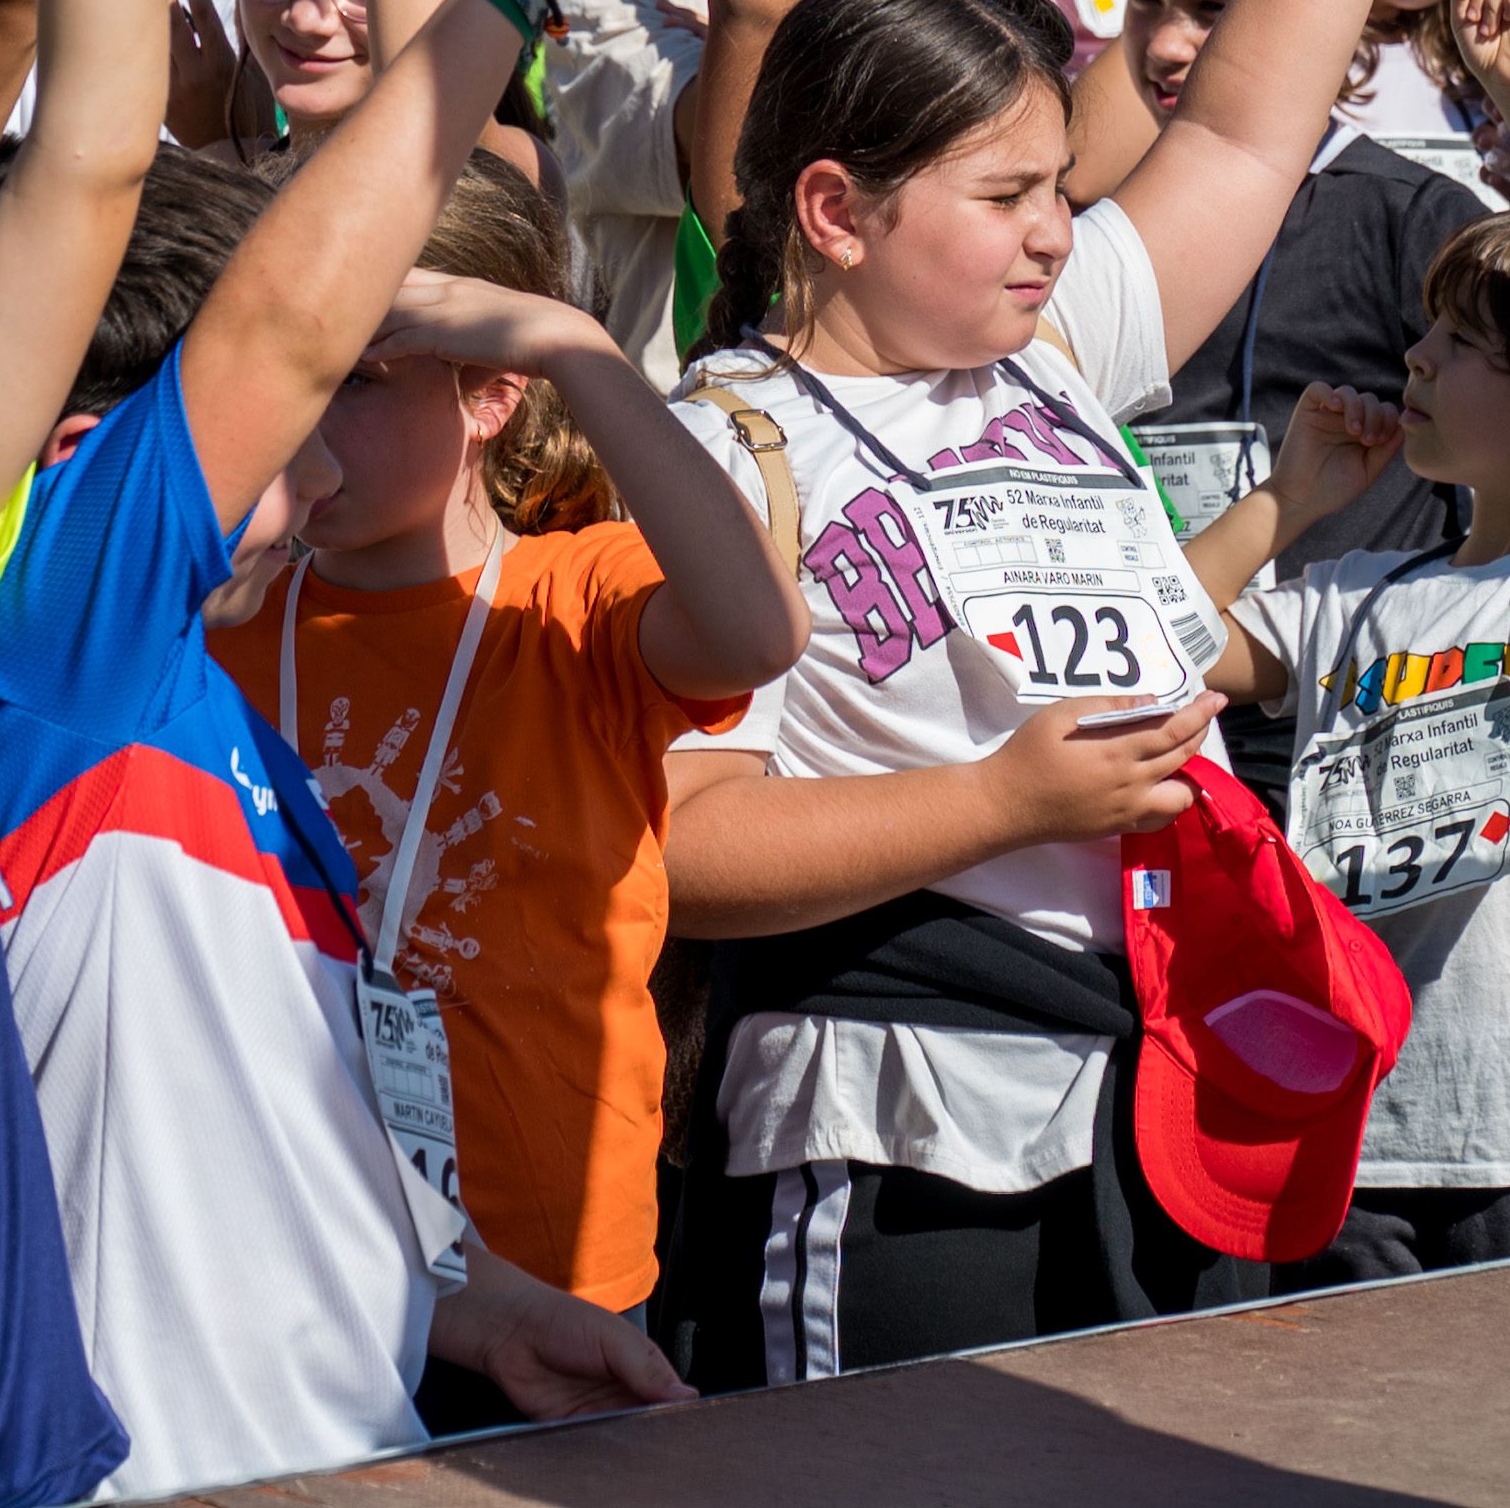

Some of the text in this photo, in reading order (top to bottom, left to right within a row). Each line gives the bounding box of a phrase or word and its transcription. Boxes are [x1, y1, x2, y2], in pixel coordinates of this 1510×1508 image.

[1150, 451, 1196, 466] Infantil
[1006, 489, 1105, 510] 52 Marxa Infantil
[1022, 514, 1038, 529] de
[1040, 515, 1106, 534] Regularitat
[1003, 570, 1041, 584] AINARA
[1042, 571, 1070, 586] VARO
[1012, 604, 1141, 688] 123
[1398, 699, 1454, 720] LASTIFIQUIS
[1427, 713, 1479, 738] Infantil
[1391, 738, 1475, 770] Regularitat
[1329, 791, 1472, 831] NOA GUIERREZ SEGARRA
[1336, 818, 1476, 907] 137
